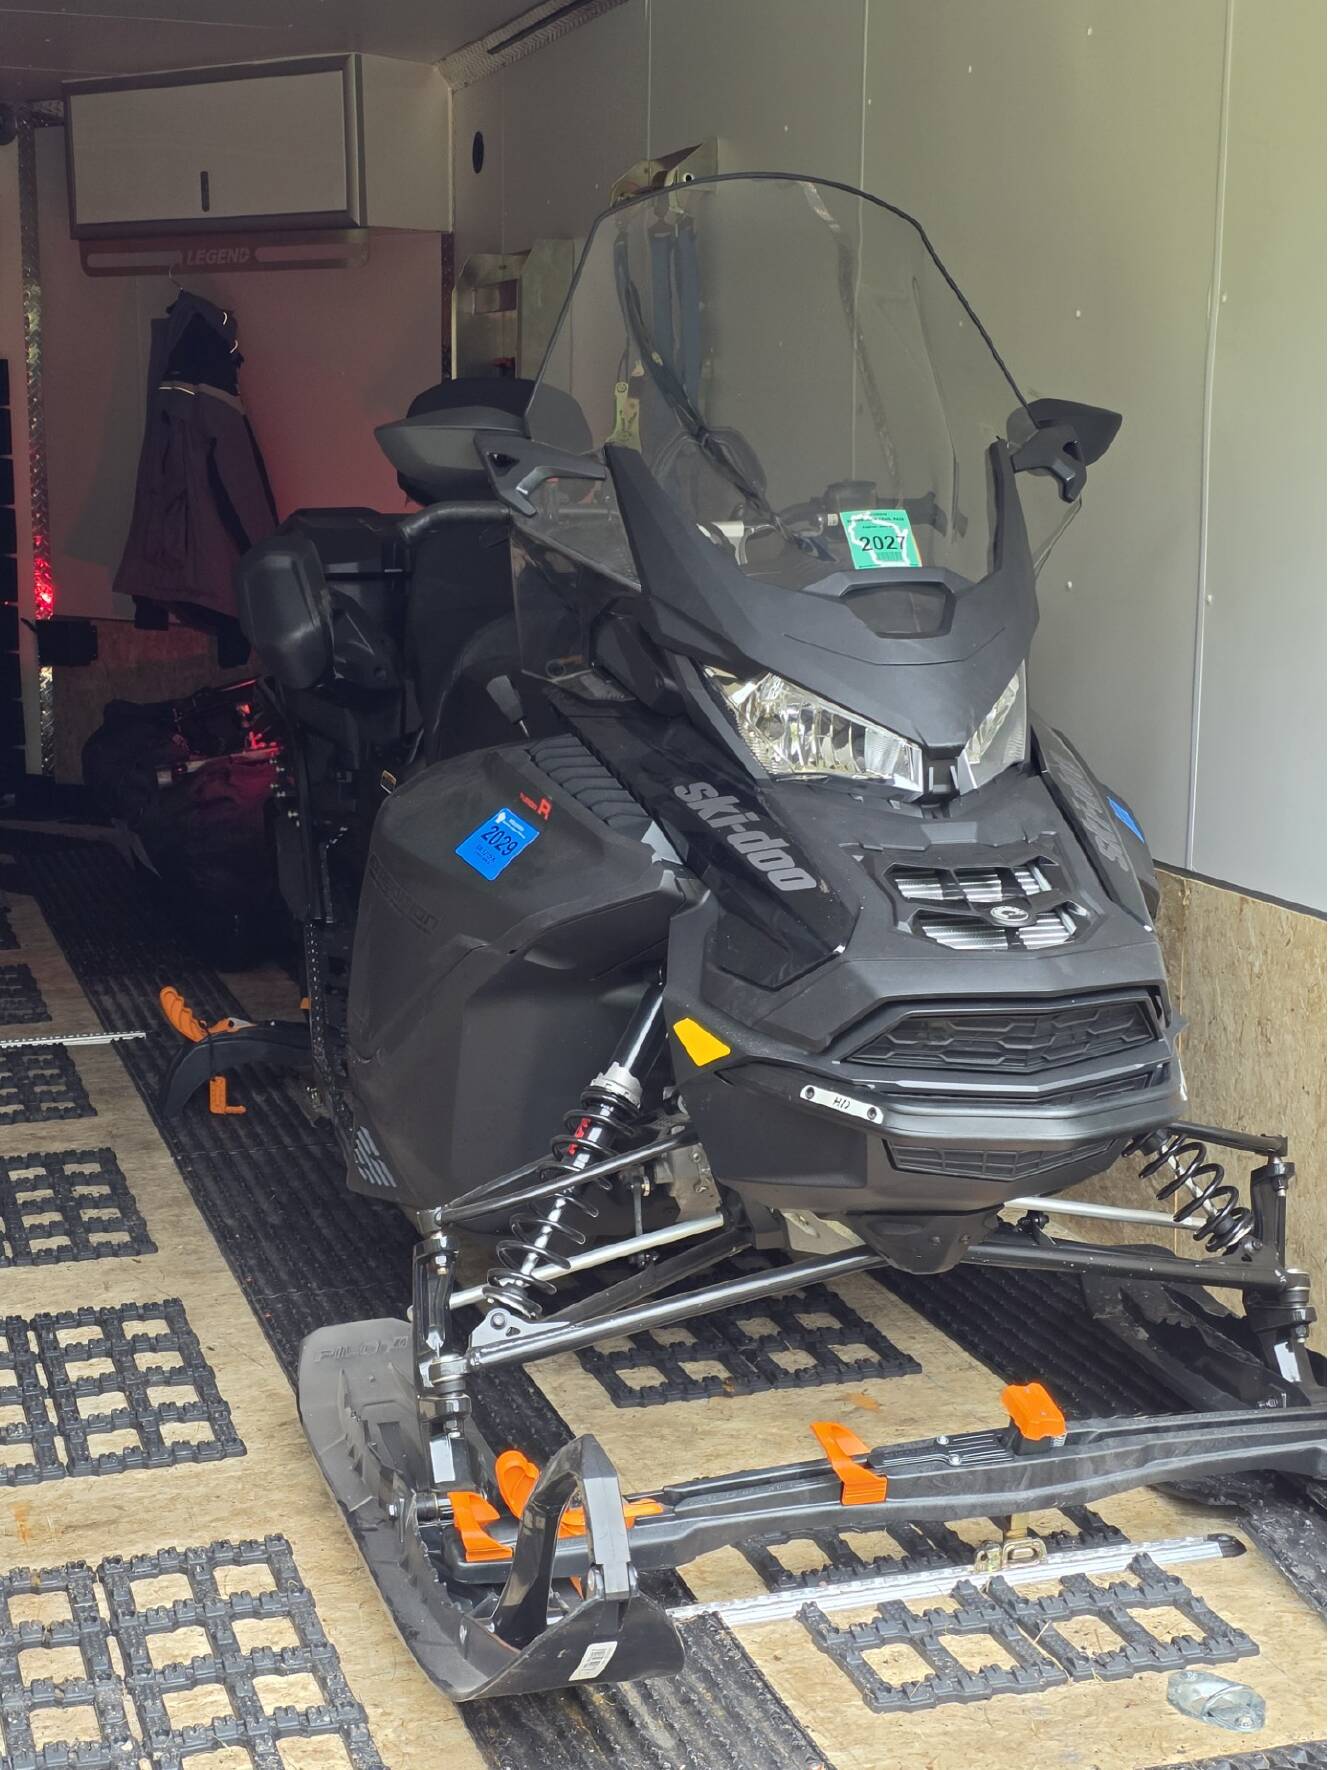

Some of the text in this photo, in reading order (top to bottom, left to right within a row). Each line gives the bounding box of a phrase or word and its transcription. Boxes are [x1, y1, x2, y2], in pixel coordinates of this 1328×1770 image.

[187, 247, 250, 266] LEGEND
[859, 535, 906, 552] 2027
[481, 825, 519, 856] 2029
